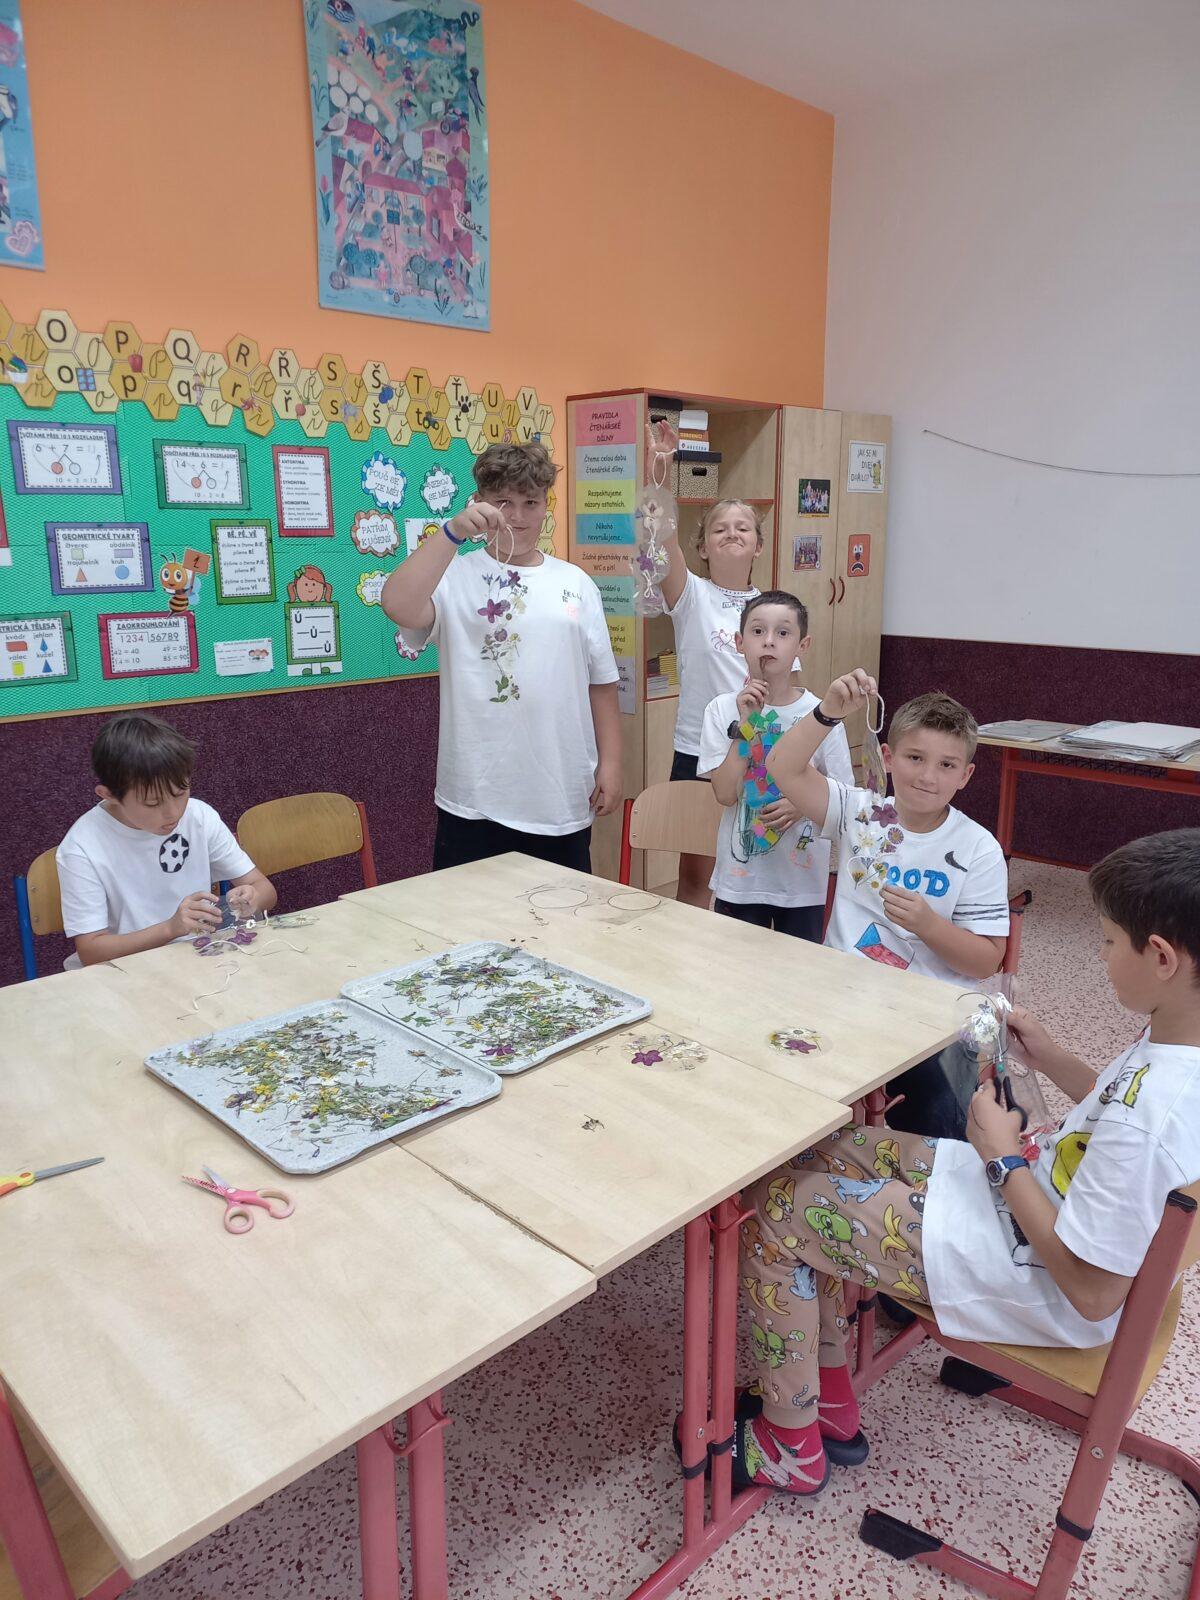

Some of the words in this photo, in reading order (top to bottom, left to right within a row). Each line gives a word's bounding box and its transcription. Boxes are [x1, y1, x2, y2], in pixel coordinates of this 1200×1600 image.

[46, 318, 67, 343] O
[115, 330, 129, 353] P
[172, 337, 194, 364] Q
[235, 342, 250, 367] R
[278, 350, 291, 378] Ř
[327, 361, 338, 381] S
[371, 363, 381, 389] Š
[413, 374, 424, 395] T
[451, 377, 462, 401] Ť
[488, 389, 498, 408] U
[522, 392, 533, 411] V
[57, 365, 74, 384] o
[121, 374, 137, 398] p
[177, 379, 192, 404] q
[231, 381, 242, 398] r
[283, 389, 292, 412] ř
[330, 400, 339, 416] s
[373, 402, 381, 424] š
[415, 408, 423, 426] t
[454, 411, 462, 432] ť
[490, 424, 499, 438] u
[523, 426, 532, 440] v
[592, 412, 619, 420] PRAVIDLA
[589, 422, 621, 431] ČTENÁŘSKÉ
[614, 453, 627, 461] dobu
[175, 460, 186, 468] 14
[587, 489, 622, 498] Respektujeme
[584, 501, 600, 509] názory
[595, 522, 613, 530] Nikoho
[61, 531, 111, 541] GEOMETRICKÉ
[0, 623, 29, 632] TRICKÁ
[31, 622, 57, 630] TĚLESA
[116, 620, 180, 630] ZAOKROUHLOVÁNÍ
[120, 634, 144, 643] 1234
[150, 632, 179, 641] 56789
[881, 862, 950, 898] OOD
